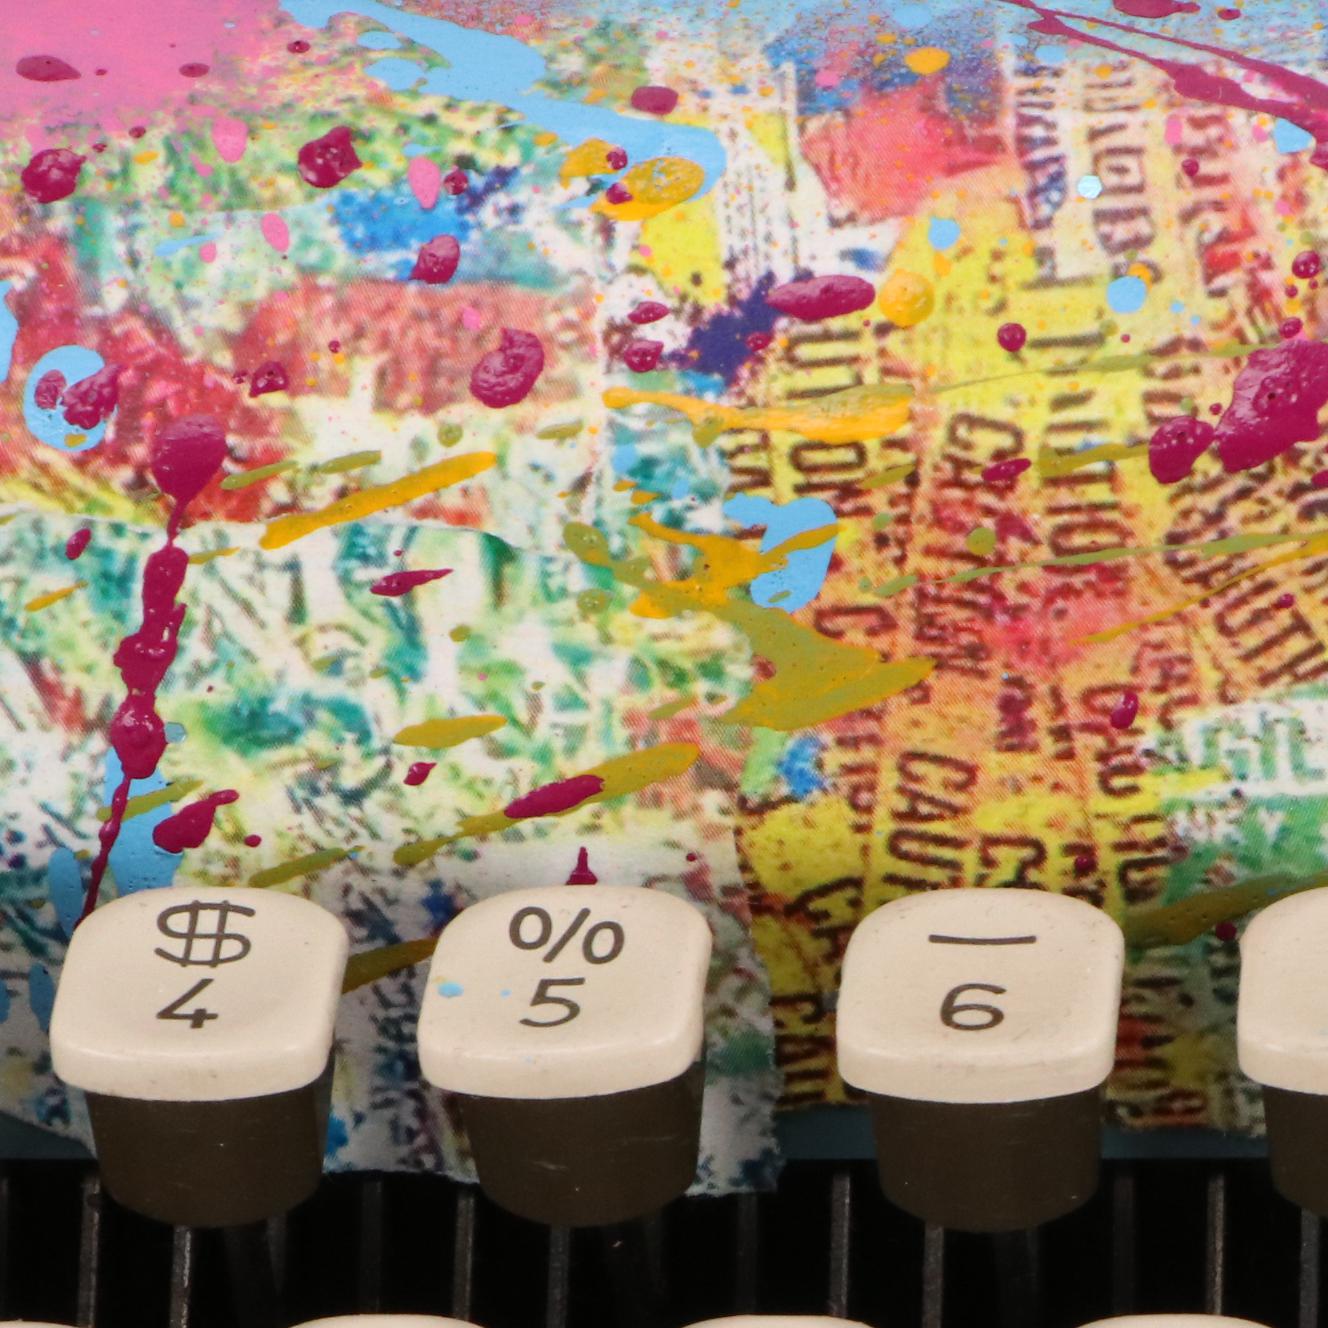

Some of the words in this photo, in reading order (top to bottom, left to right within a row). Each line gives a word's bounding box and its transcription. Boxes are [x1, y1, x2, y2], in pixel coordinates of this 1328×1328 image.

[154, 899, 256, 969] $
[156, 978, 219, 1030] 4
[519, 977, 586, 1028] 5
[939, 983, 1007, 1032] 6
